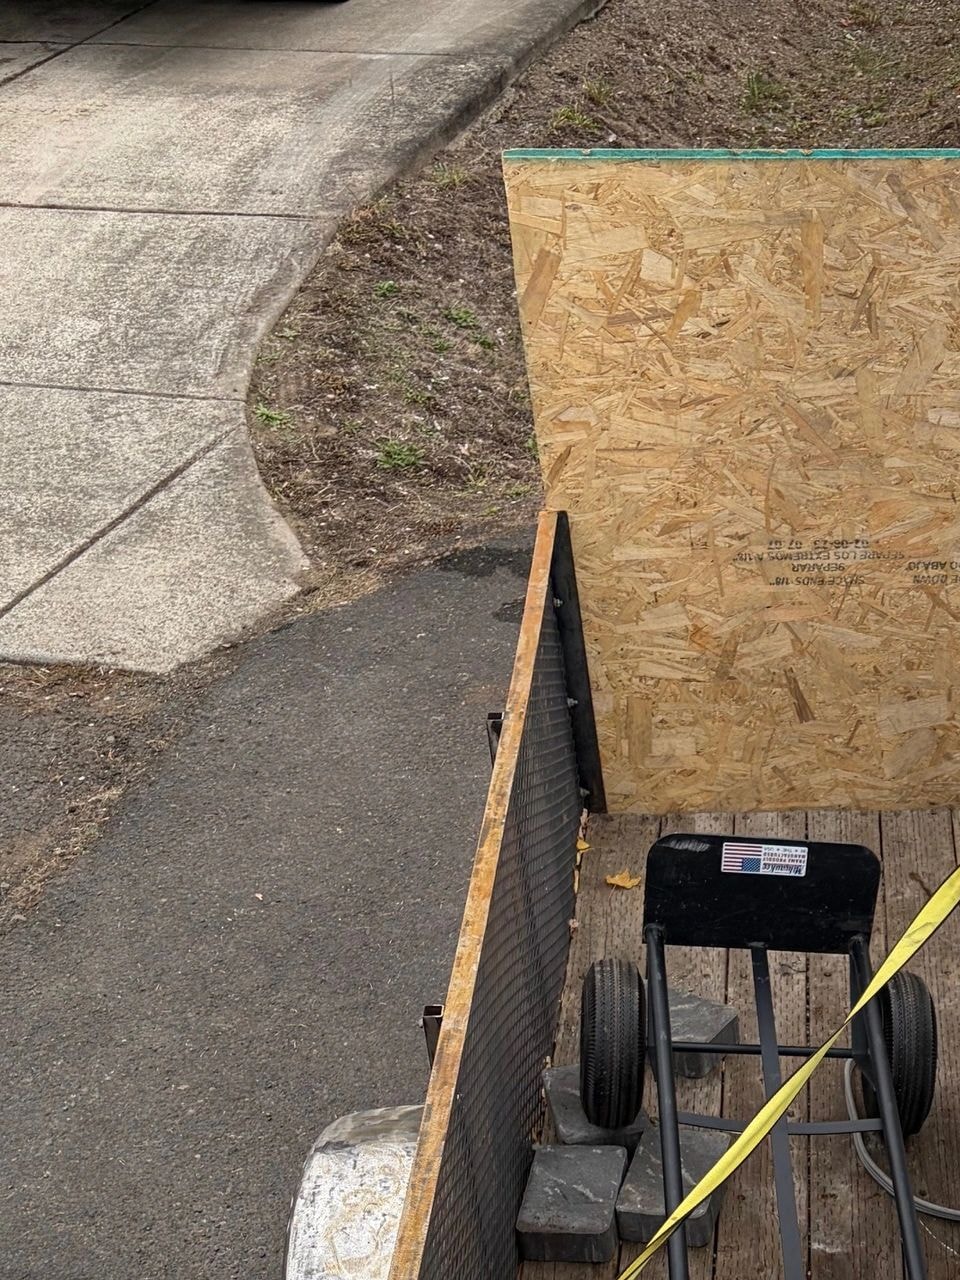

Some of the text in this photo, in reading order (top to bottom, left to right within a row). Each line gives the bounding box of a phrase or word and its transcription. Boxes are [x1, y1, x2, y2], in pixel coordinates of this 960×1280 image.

[767, 551, 831, 560] EXTREMOS
[834, 551, 857, 560] LOS
[908, 560, 947, 570] ABAJO
[795, 576, 824, 586] ENDS
[762, 863, 805, 874] Milwaukee
